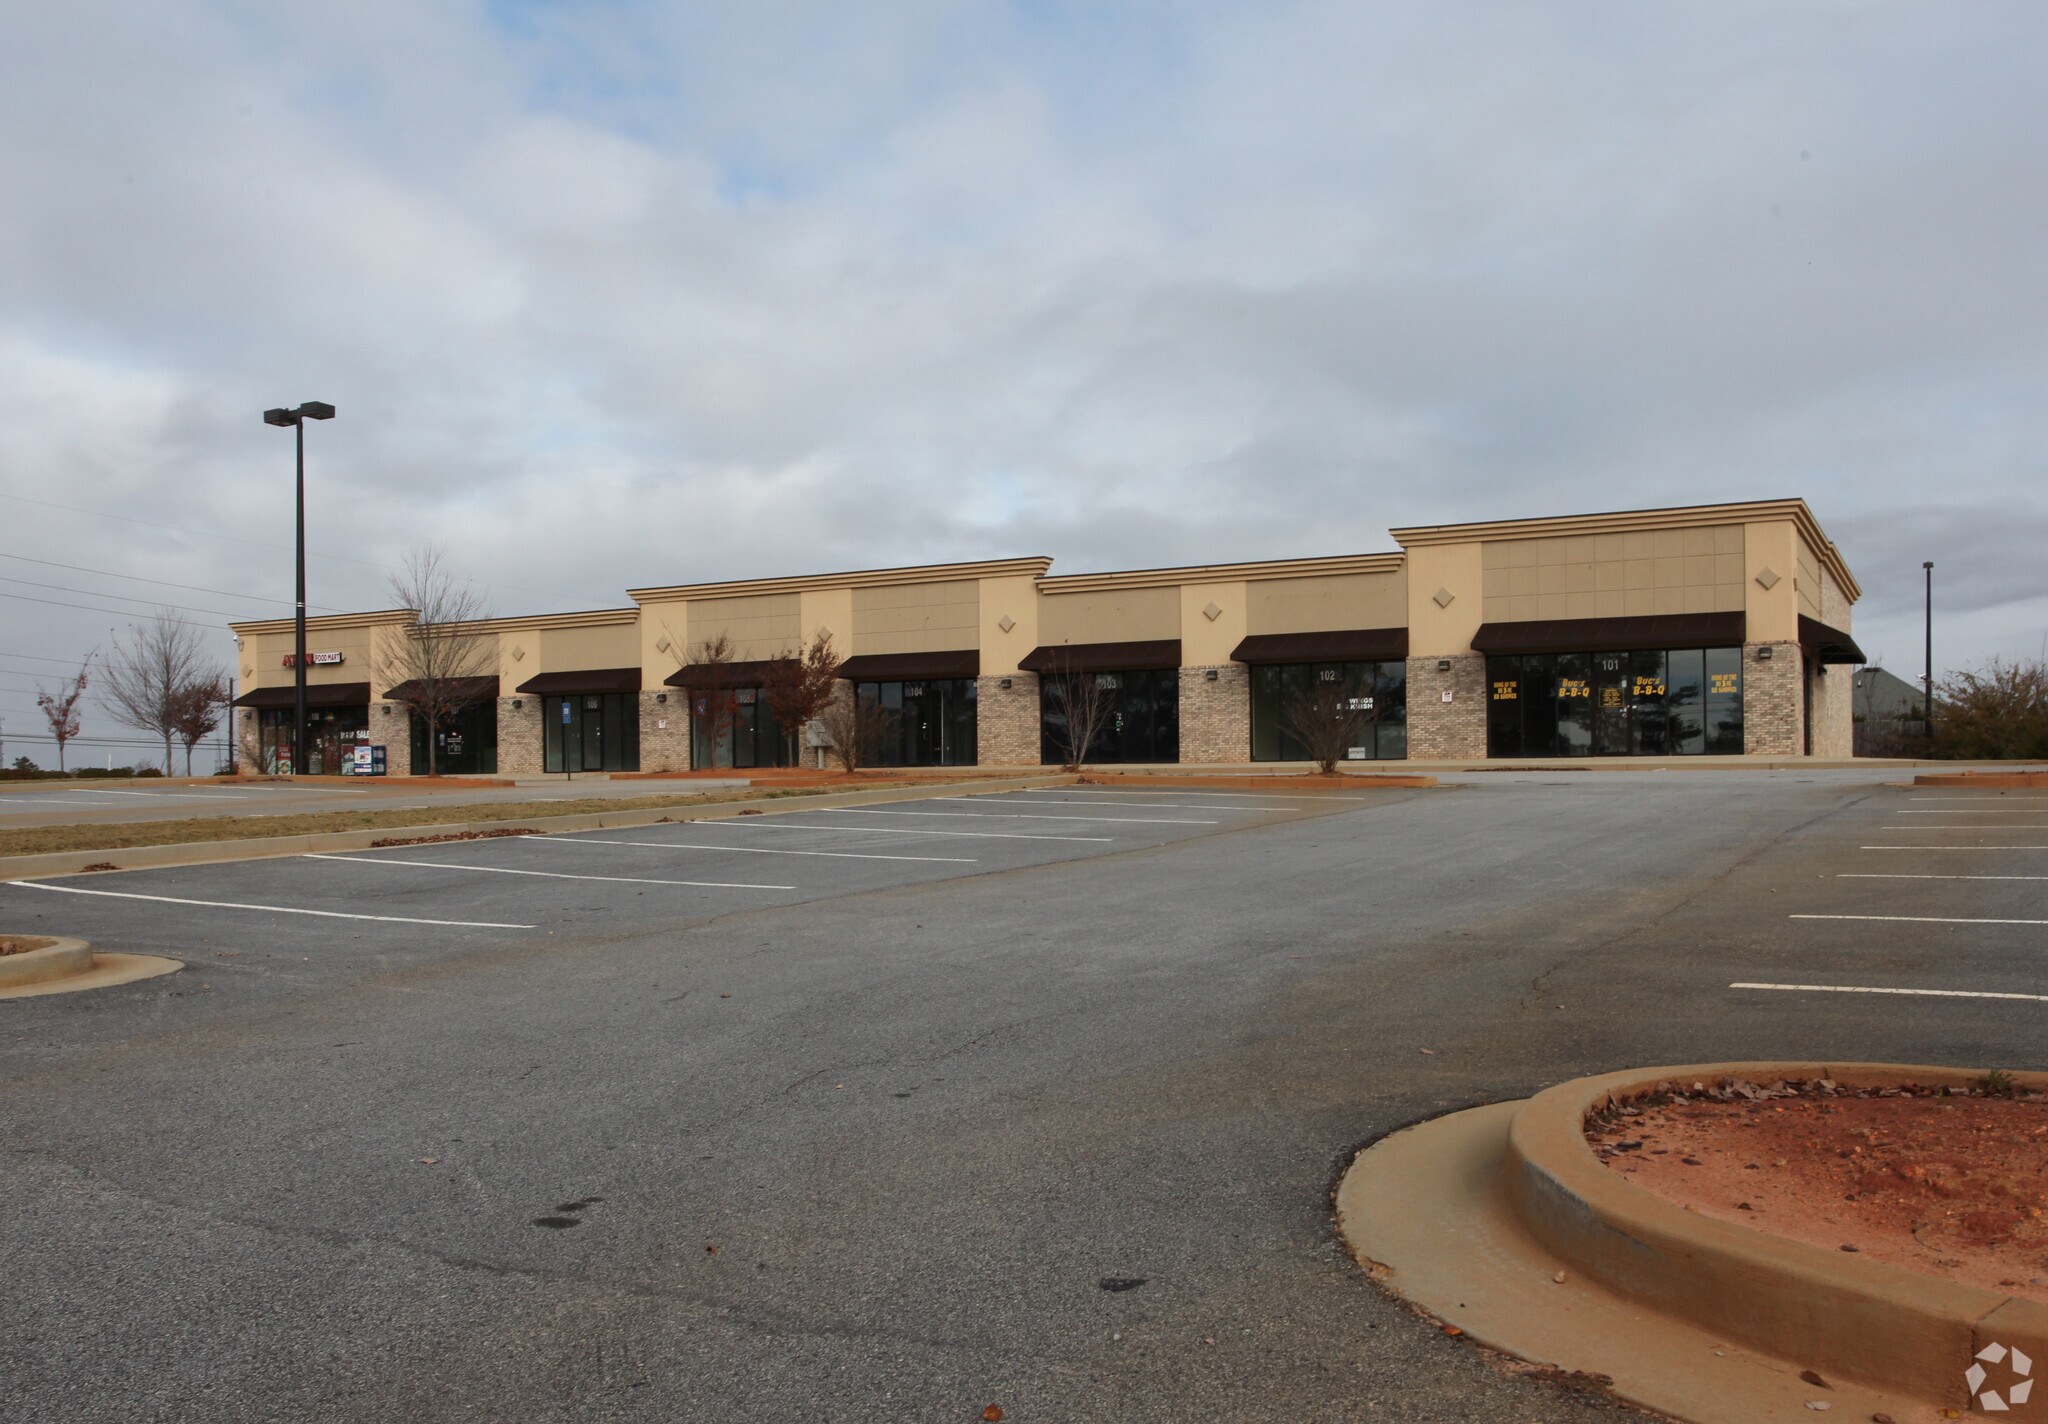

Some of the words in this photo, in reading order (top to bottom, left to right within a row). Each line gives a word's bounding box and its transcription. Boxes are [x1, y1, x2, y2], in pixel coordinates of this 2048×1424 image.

[315, 654, 327, 662] FOOD
[328, 653, 340, 661] MART
[1602, 659, 1619, 670] 101
[1320, 670, 1335, 681] 102
[1103, 678, 1117, 689] 103
[911, 686, 923, 697] 104
[1559, 687, 1590, 698] B-B-Q
[1633, 685, 1665, 696] B-B-Q
[587, 699, 598, 709] 106
[356, 730, 370, 739] SALE
